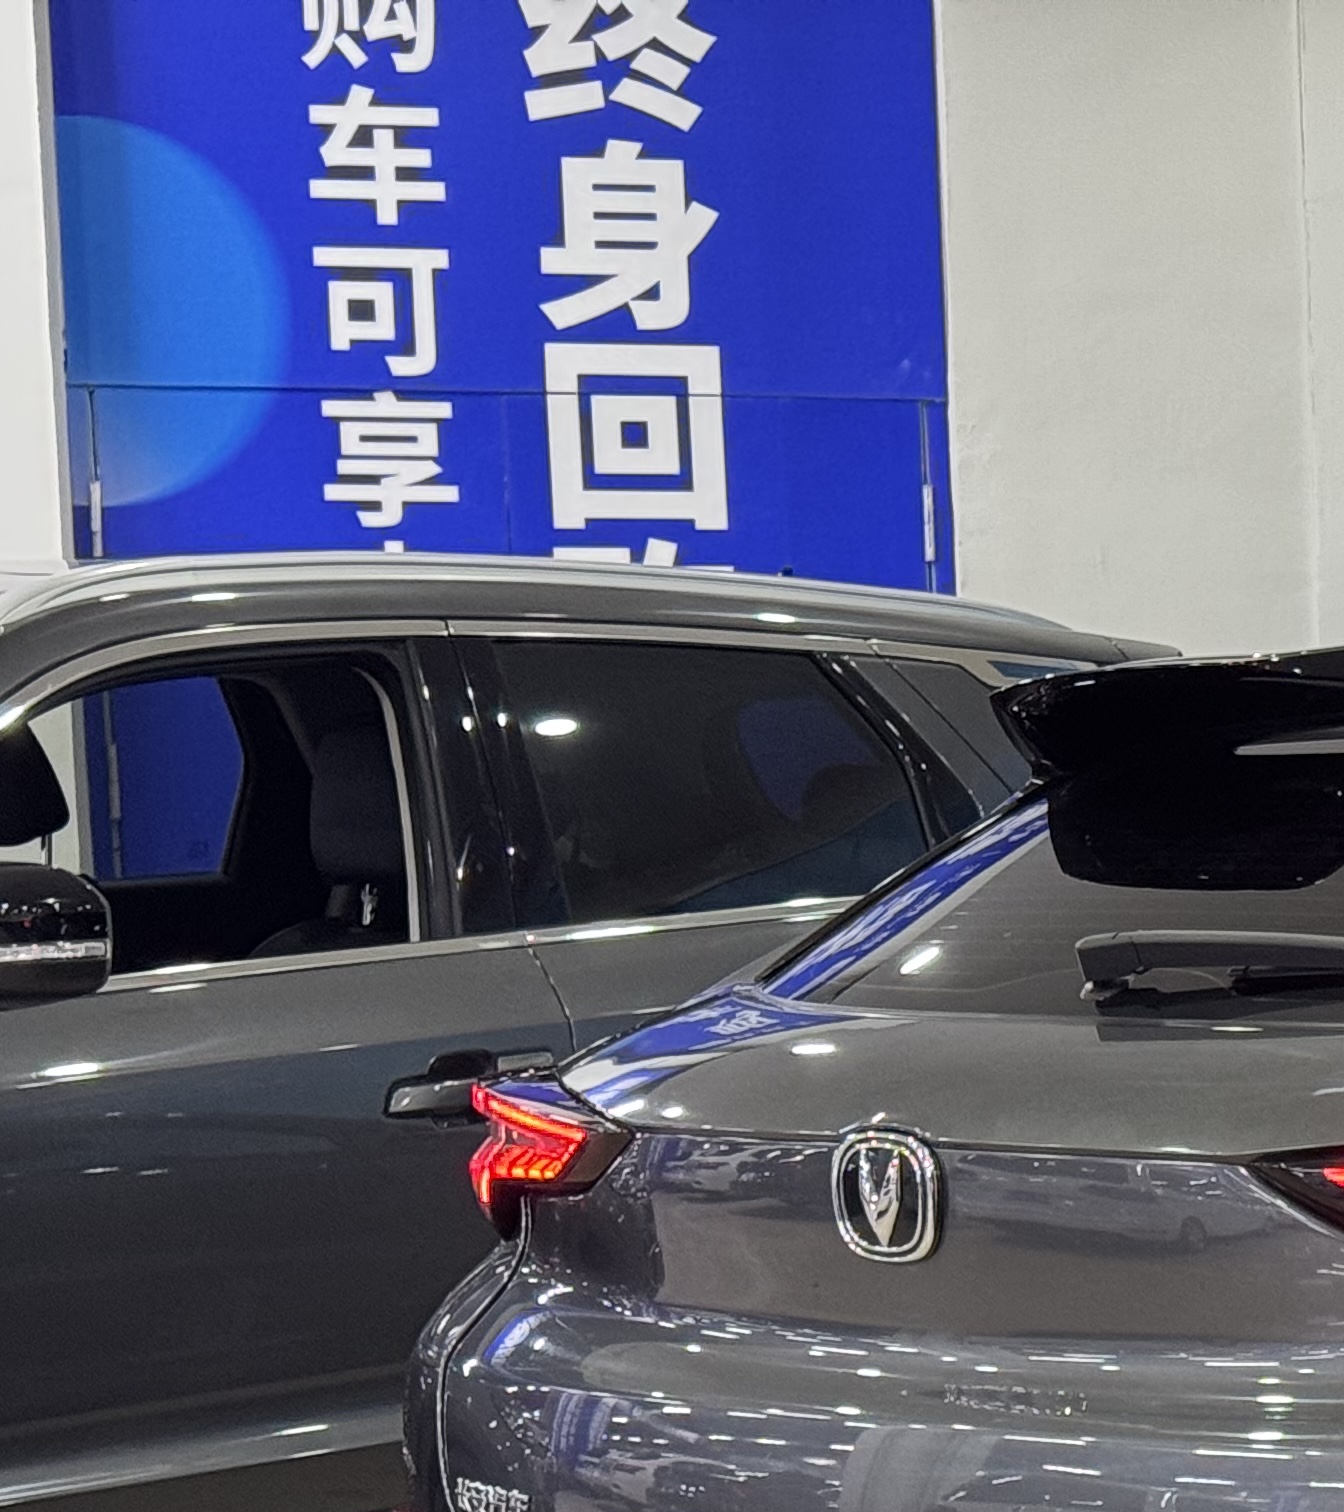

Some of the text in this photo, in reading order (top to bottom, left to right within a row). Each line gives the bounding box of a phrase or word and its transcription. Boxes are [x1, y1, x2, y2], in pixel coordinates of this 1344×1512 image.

[302, 0, 460, 553] 购车可享
[518, 0, 734, 573] 终身回
